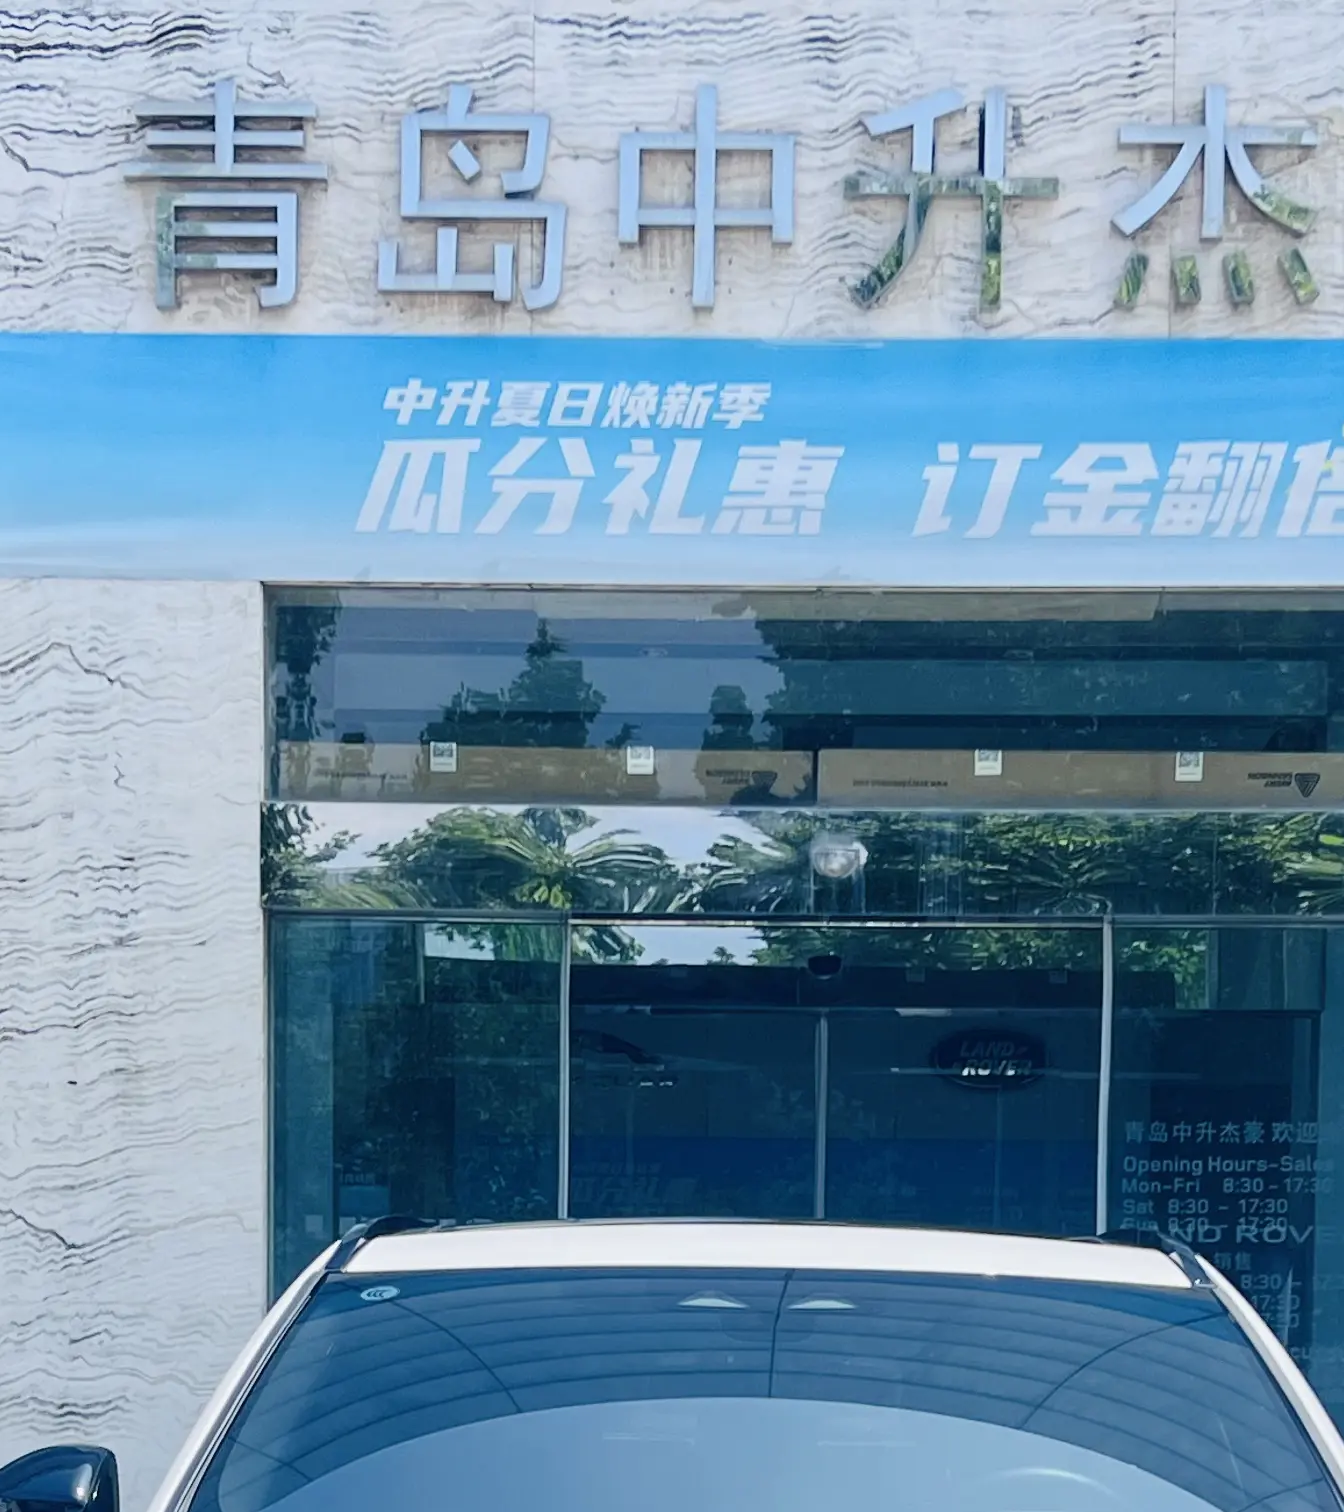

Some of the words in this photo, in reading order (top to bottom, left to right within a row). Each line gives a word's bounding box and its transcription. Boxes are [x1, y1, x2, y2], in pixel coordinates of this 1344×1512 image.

[383, 378, 771, 430] 中升夏日焕新季
[356, 436, 845, 536] 瓜分礼惠
[960, 1040, 1015, 1057] LAND
[961, 1059, 1032, 1077] ROVER
[1125, 1121, 1265, 1144] 青岛中升杰豪
[1123, 1156, 1203, 1175] Opening
[1121, 1178, 1200, 1193] Mon-Fri
[1222, 1178, 1264, 1194] 8:30
[1123, 1199, 1154, 1214] Sat
[1168, 1199, 1209, 1214] 8:30
[1239, 1199, 1288, 1214] 17:30
